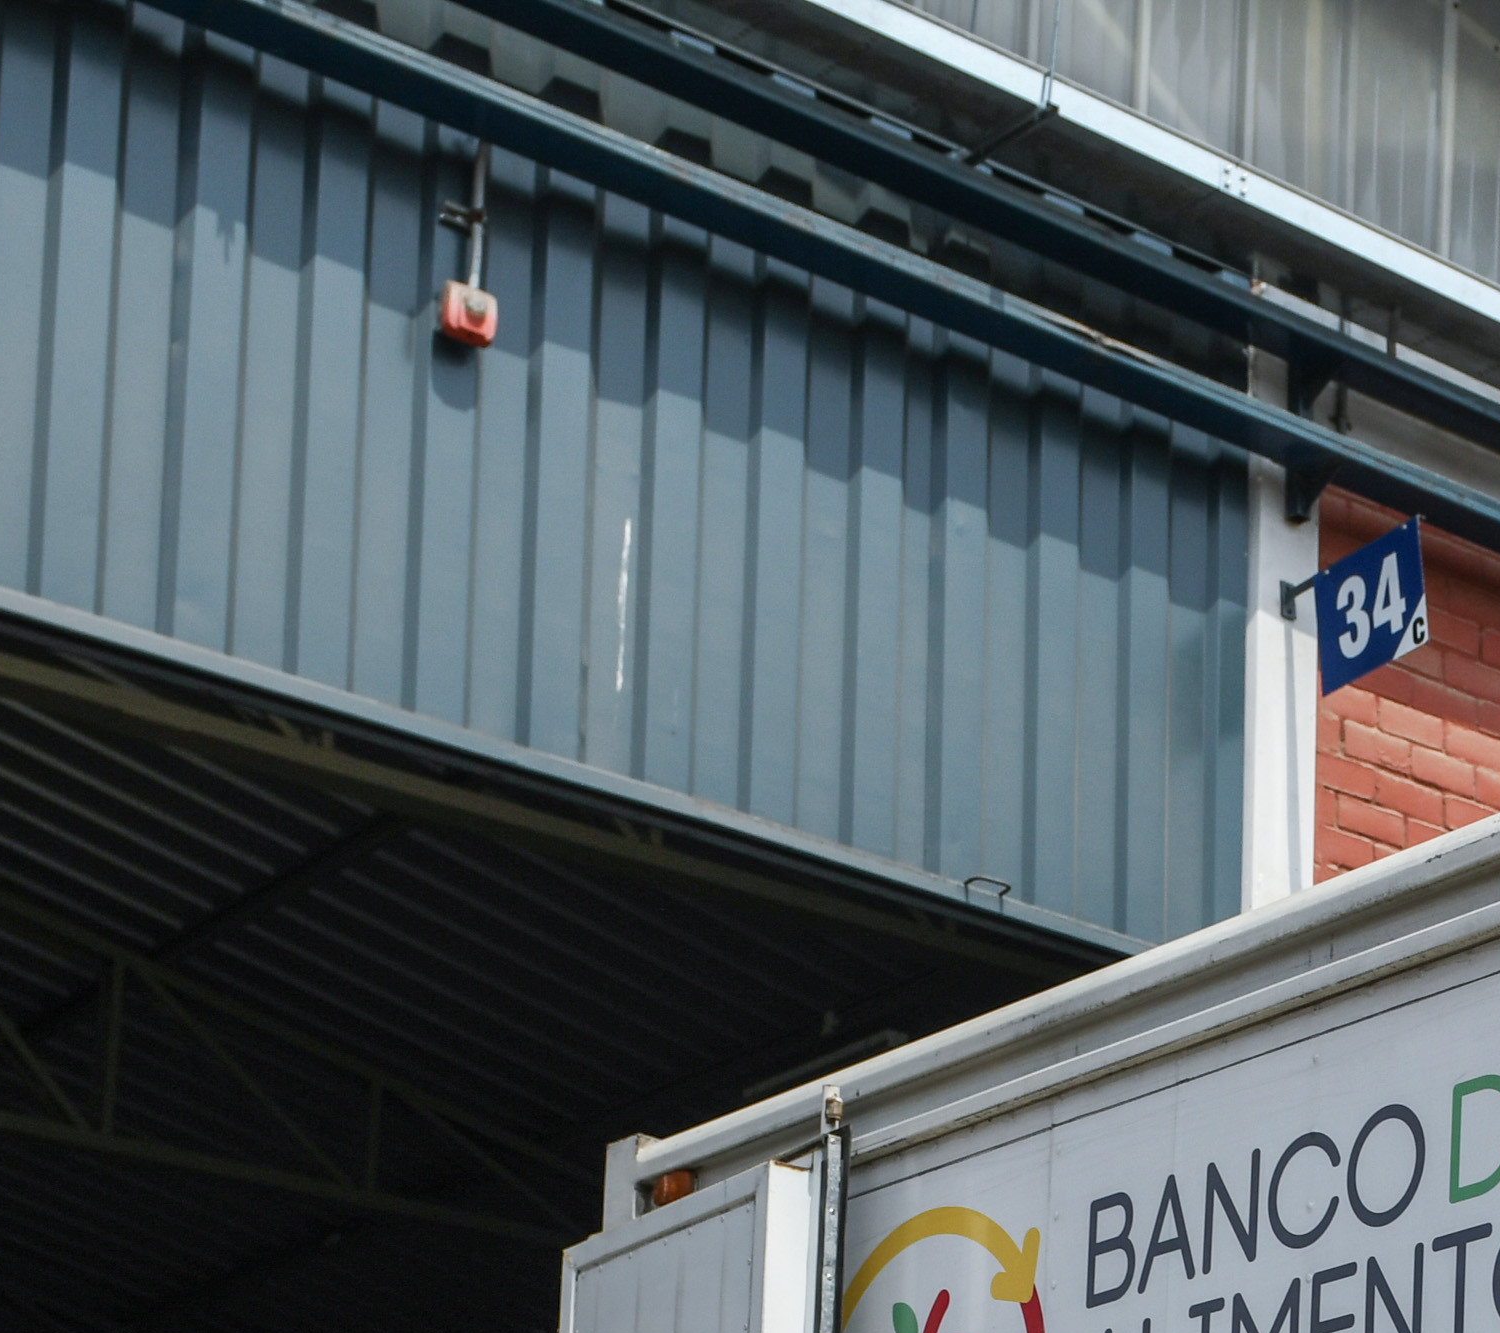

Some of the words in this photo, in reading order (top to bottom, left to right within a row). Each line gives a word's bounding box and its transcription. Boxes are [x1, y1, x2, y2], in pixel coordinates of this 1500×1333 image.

[1336, 551, 1407, 660] 34
[1412, 616, 1425, 645] C
[1086, 1103, 1426, 1310] BANCO
